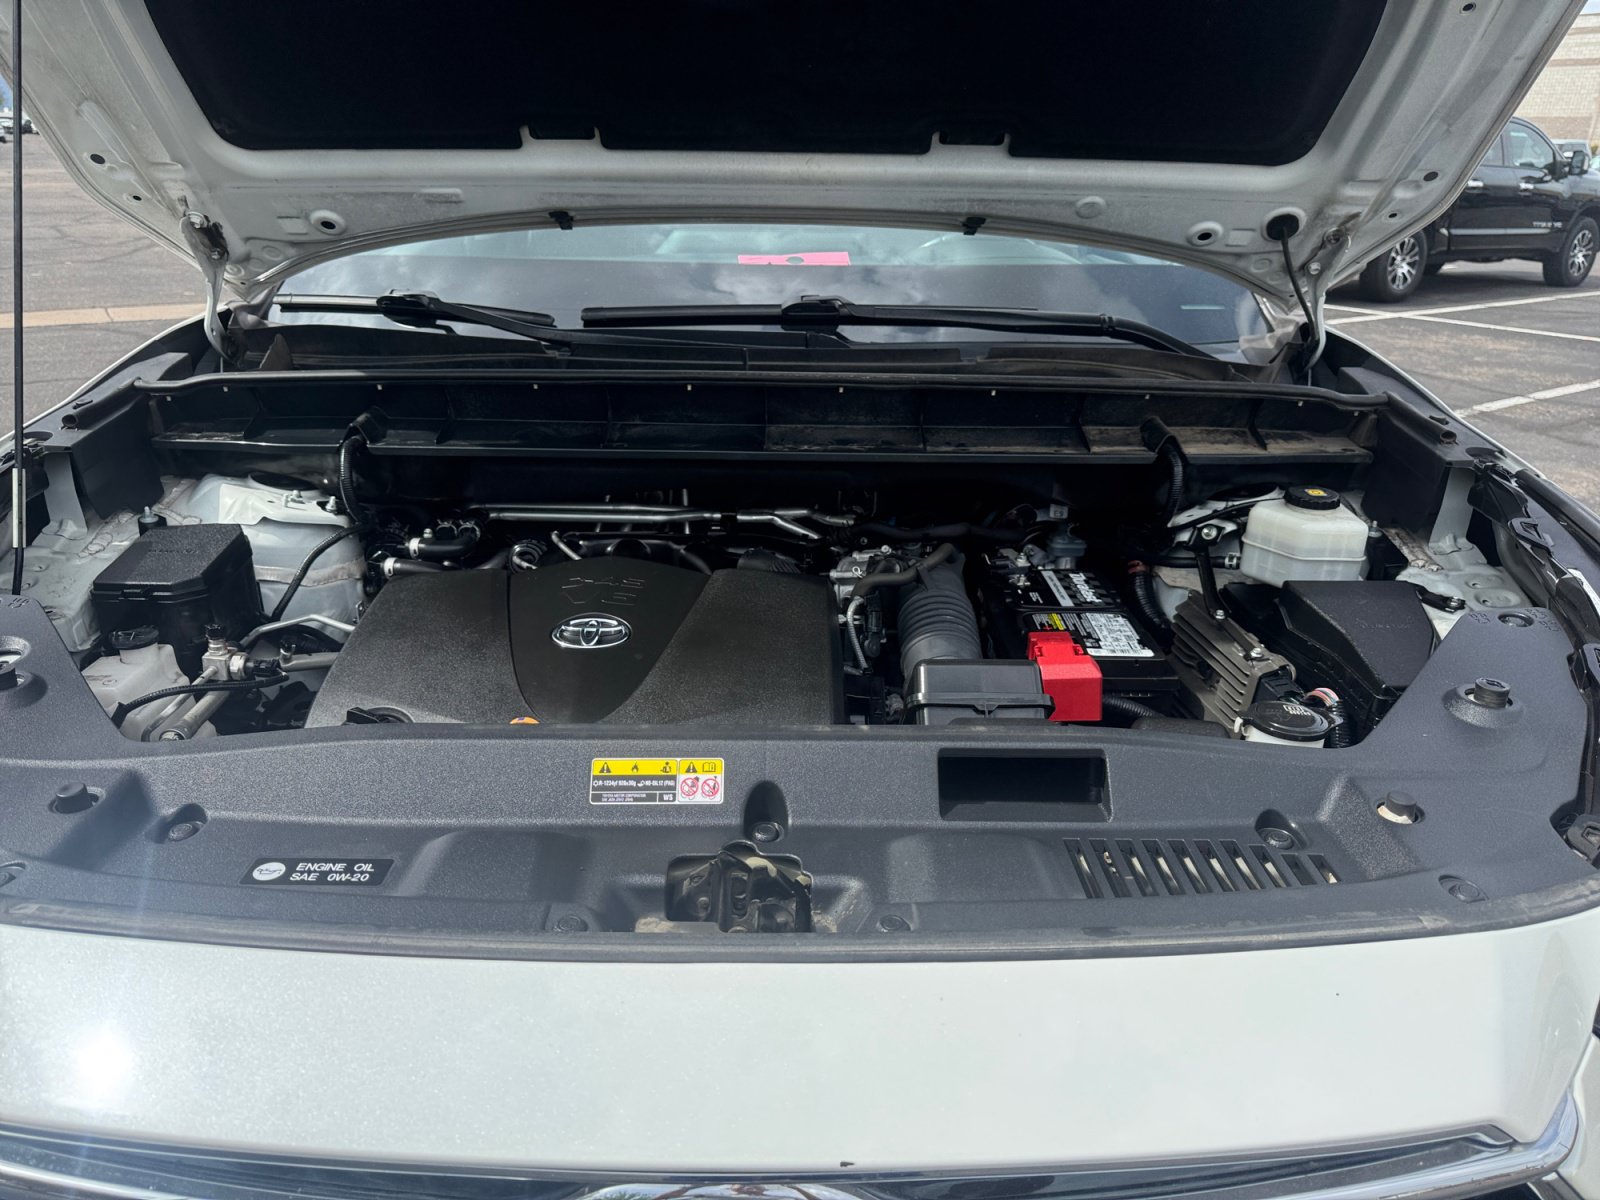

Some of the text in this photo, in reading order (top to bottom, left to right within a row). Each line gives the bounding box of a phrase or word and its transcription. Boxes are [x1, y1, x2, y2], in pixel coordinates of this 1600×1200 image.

[296, 862, 374, 872] ENGINE OIL
[290, 873, 369, 882] SAE 0W-20
